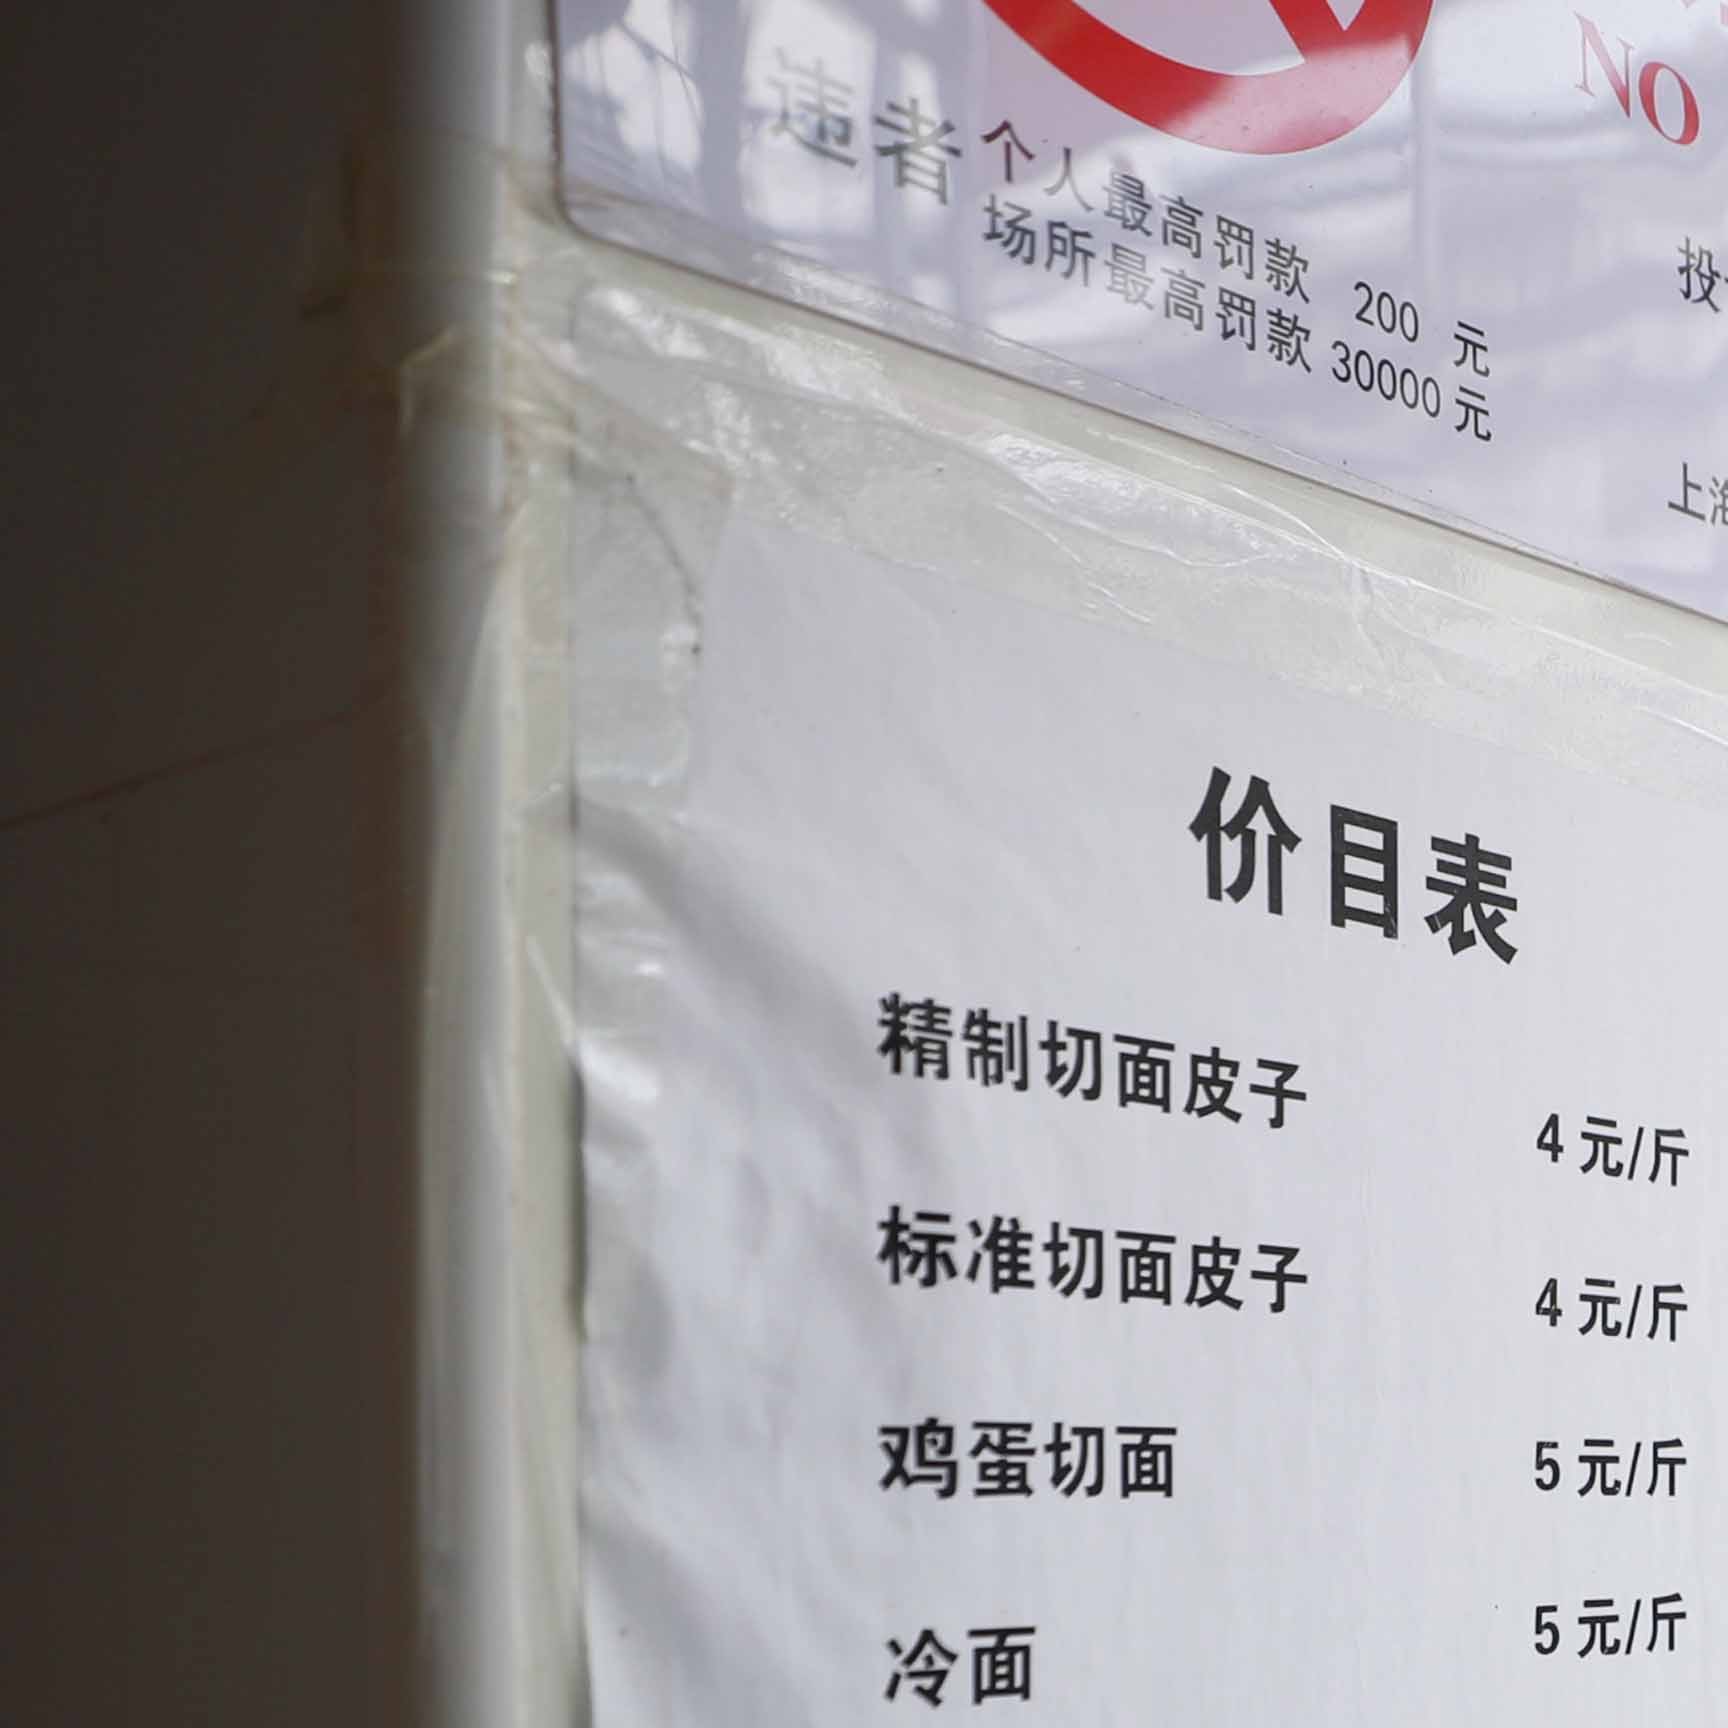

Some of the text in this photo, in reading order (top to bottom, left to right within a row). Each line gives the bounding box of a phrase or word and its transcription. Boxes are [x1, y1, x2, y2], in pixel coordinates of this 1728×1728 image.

[765, 48, 963, 206] 违者
[1574, 11, 1701, 147] NO
[981, 119, 1491, 380] 个人最高罚款 200 元
[981, 192, 1313, 374] 场所最高罚款
[1188, 765, 1519, 965] 价目表
[877, 991, 1308, 1129] 精制切面皮子
[877, 1204, 1309, 1314] 标准切面皮子
[877, 1416, 1178, 1500] 鸡蛋切面
[884, 1625, 1037, 1709] 冷面
